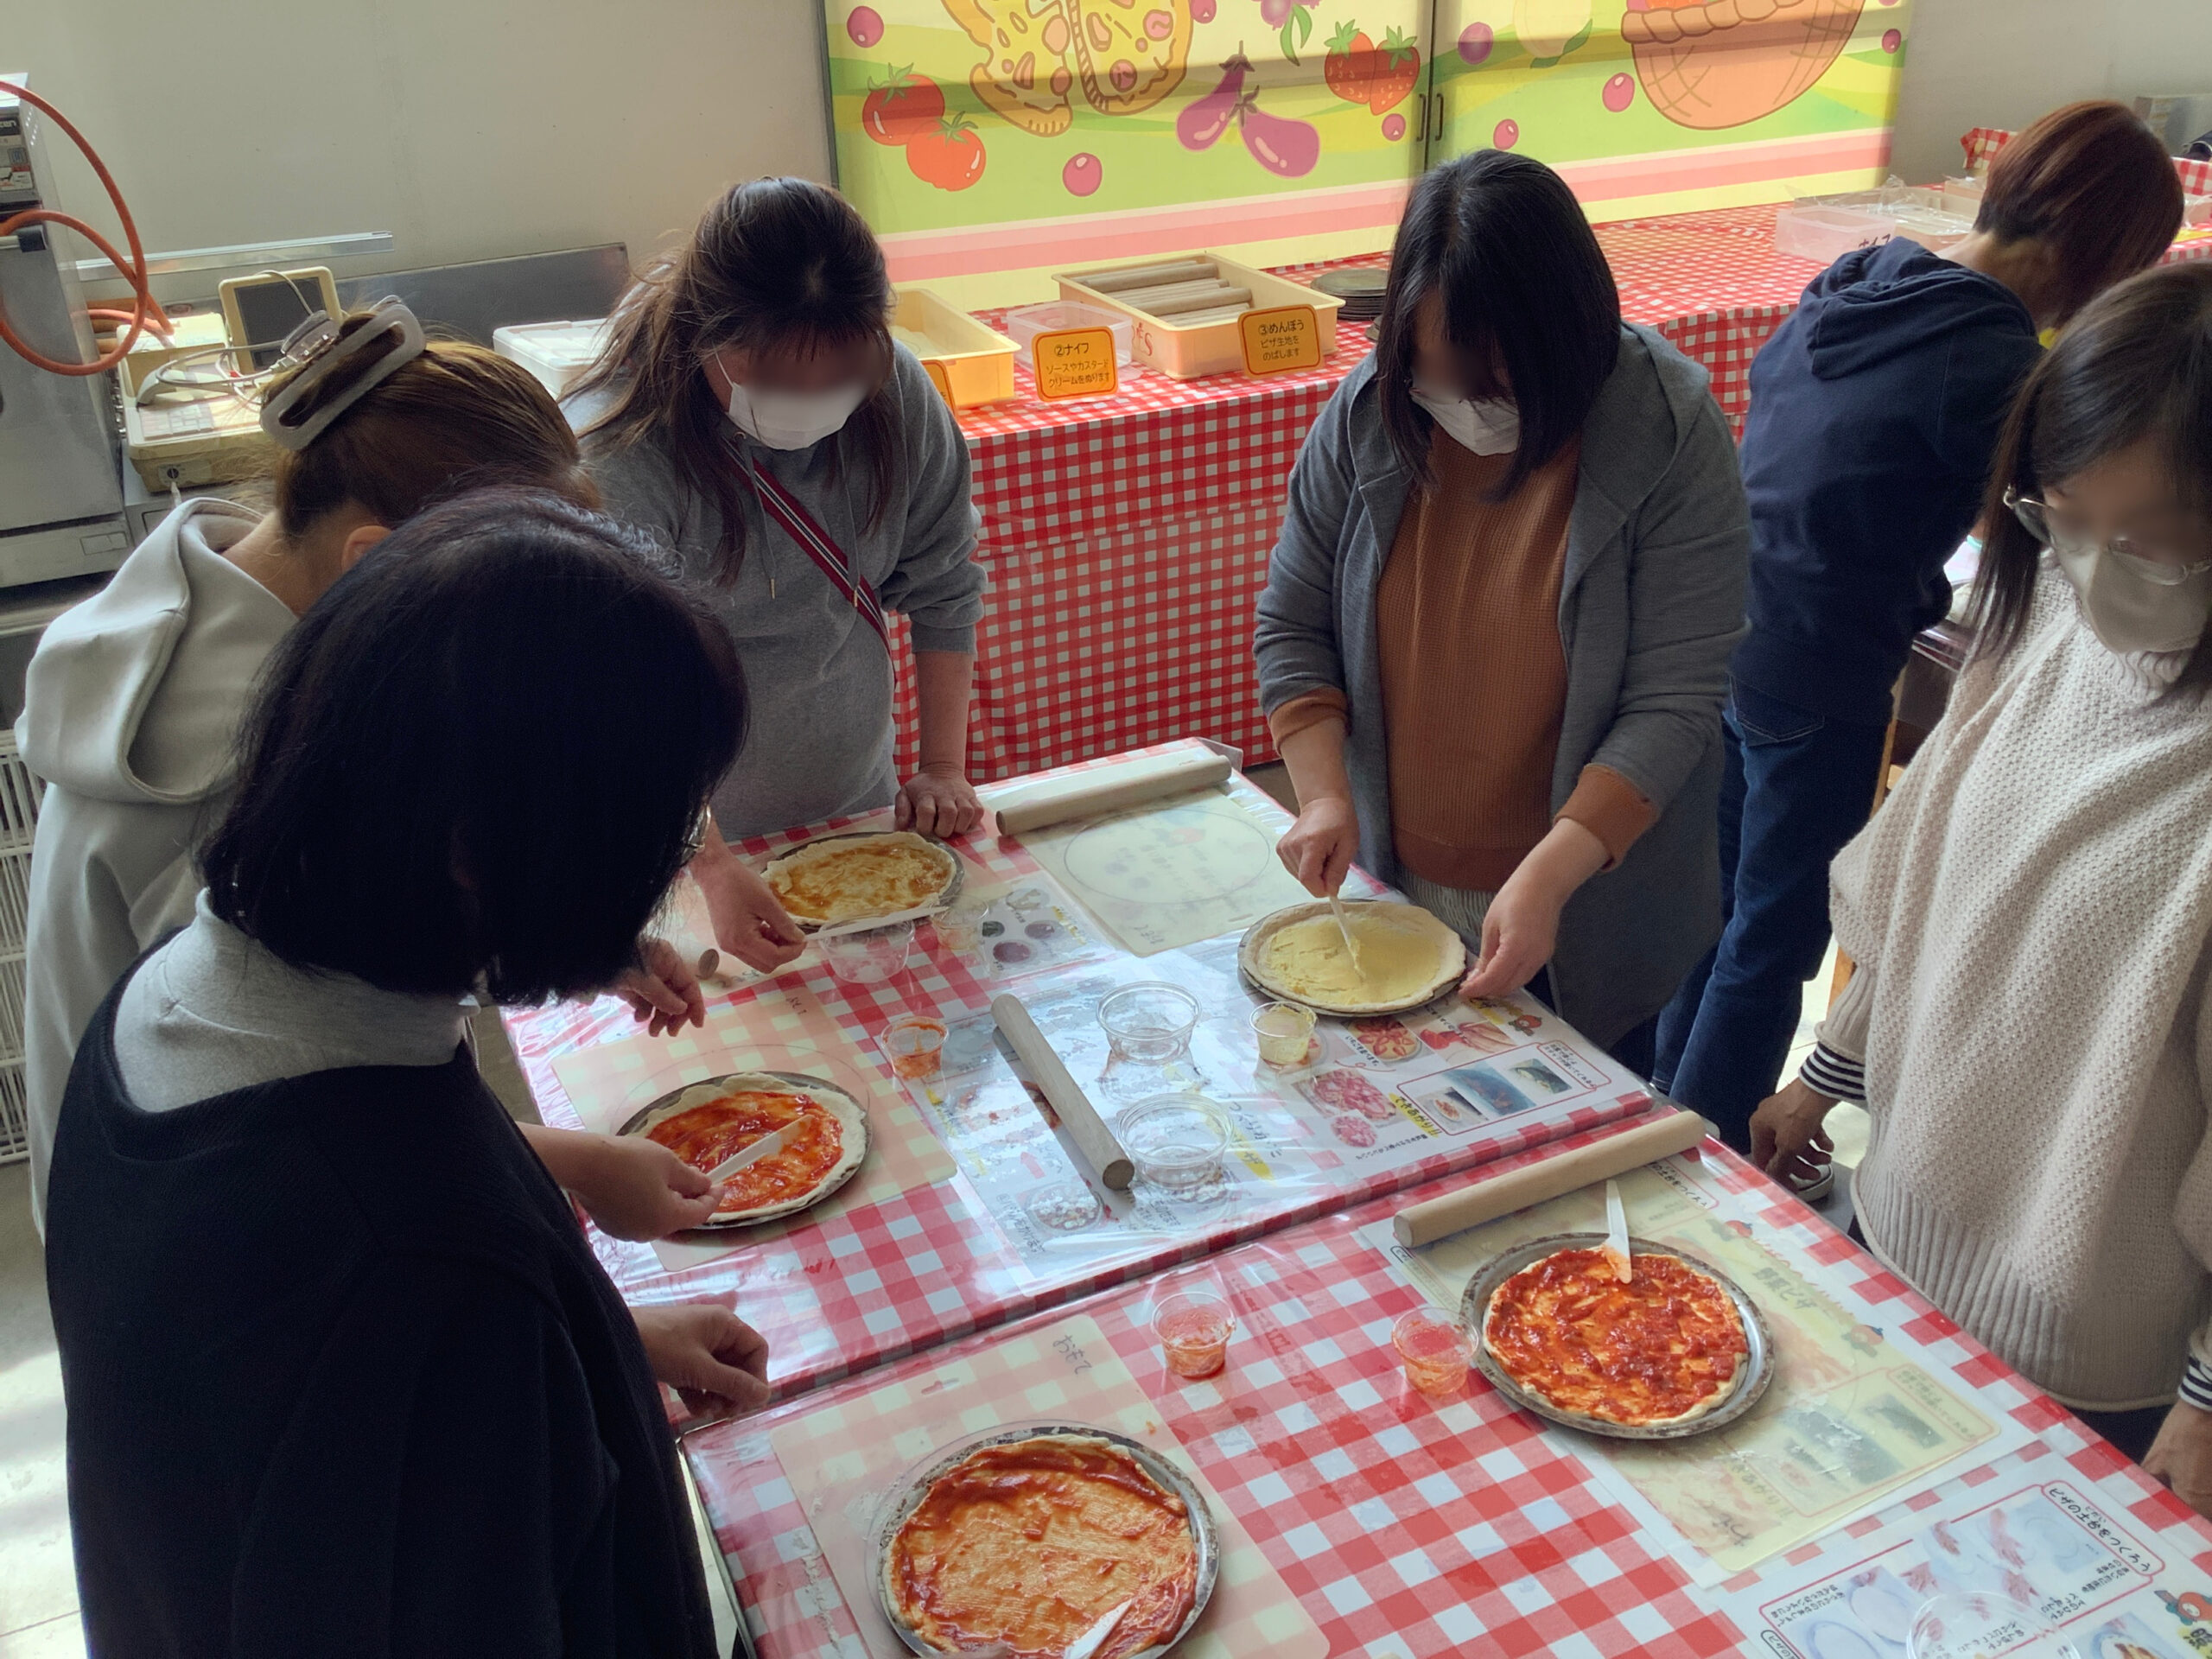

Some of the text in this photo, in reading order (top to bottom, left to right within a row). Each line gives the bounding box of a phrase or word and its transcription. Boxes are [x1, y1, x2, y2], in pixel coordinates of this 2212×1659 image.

[1257, 319, 1306, 335] ③めんぼう
[1053, 341, 1090, 357] ②ナイフ
[1260, 334, 1300, 349] ピザ生地を
[1262, 347, 1300, 361] のばします
[1048, 372, 1110, 389] クリームをぬります
[1052, 1334, 1093, 1375] おもて
[2048, 1486, 2152, 1574] ピザの土台をつくろう
